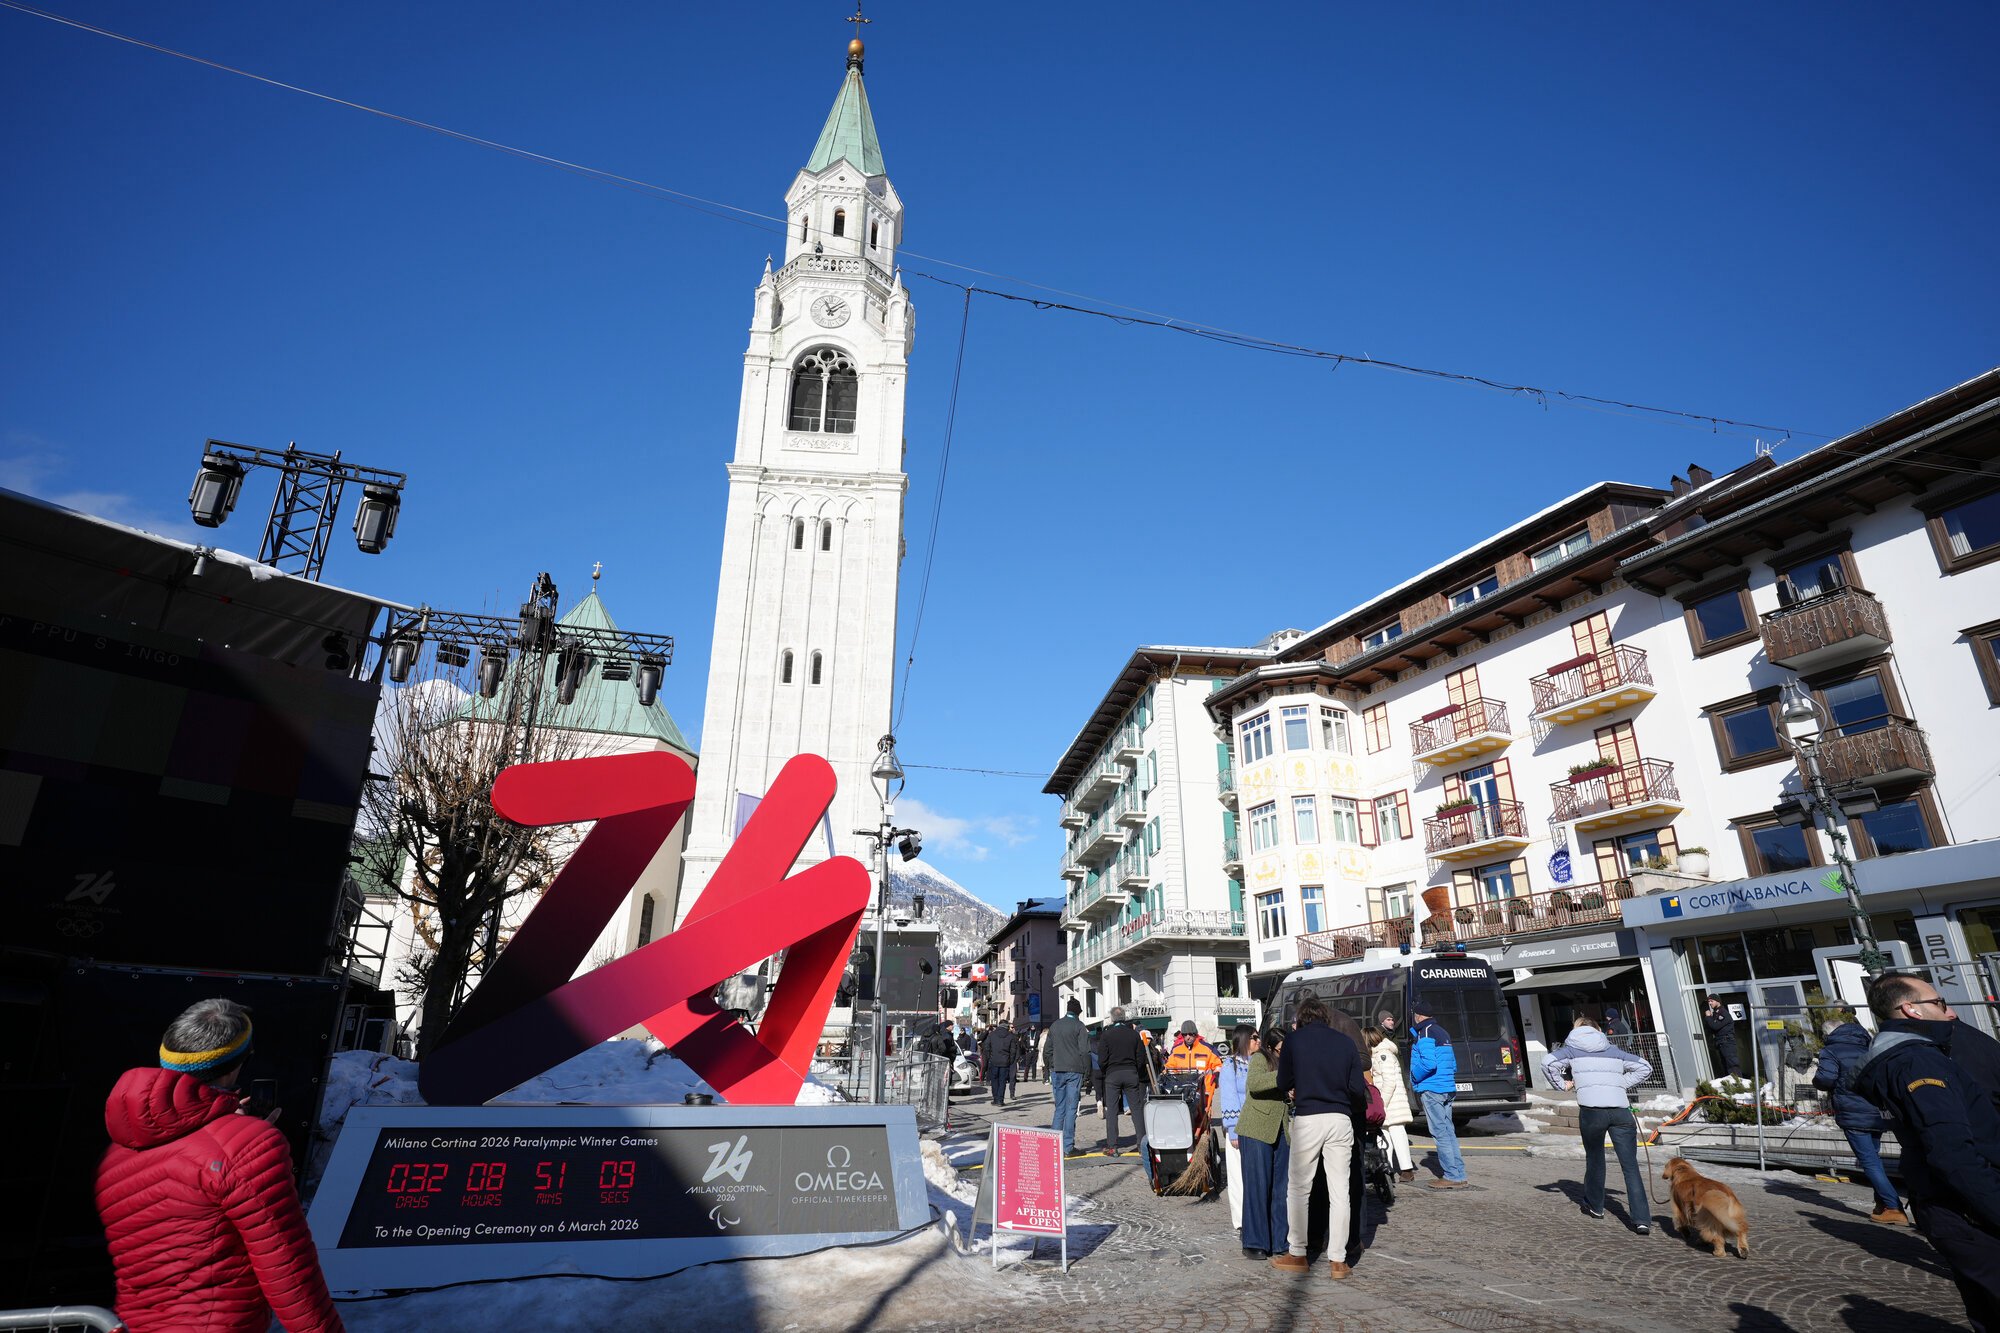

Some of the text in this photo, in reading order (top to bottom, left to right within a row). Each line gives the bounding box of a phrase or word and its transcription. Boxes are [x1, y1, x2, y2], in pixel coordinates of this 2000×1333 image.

[1689, 881, 1813, 910] CORTINABANCA
[1166, 909, 1245, 924] HOTEL
[1580, 941, 1618, 951] TECNICA
[1518, 948, 1556, 959] NORDICA
[1925, 934, 1959, 987] BANK
[1420, 968, 1488, 980] CARABINIERI
[384, 1135, 659, 1150] Milano Cortina 2026 Paralympic Winter Games
[386, 1160, 636, 1193] 032 08 51 09
[795, 1171, 884, 1192] OMEGA
[686, 1184, 767, 1194] MILANO CORTINA
[395, 1191, 630, 1209] DAYS HOURS MINS SECS
[716, 1193, 736, 1202] 2026
[791, 1194, 888, 1205] OFFICIAL TIMEKEEPER
[1016, 1207, 1061, 1219] APERTO
[1029, 1217, 1060, 1228] OPEN
[375, 1219, 639, 1240] To the Opening Ceremony on 6 March 2026
